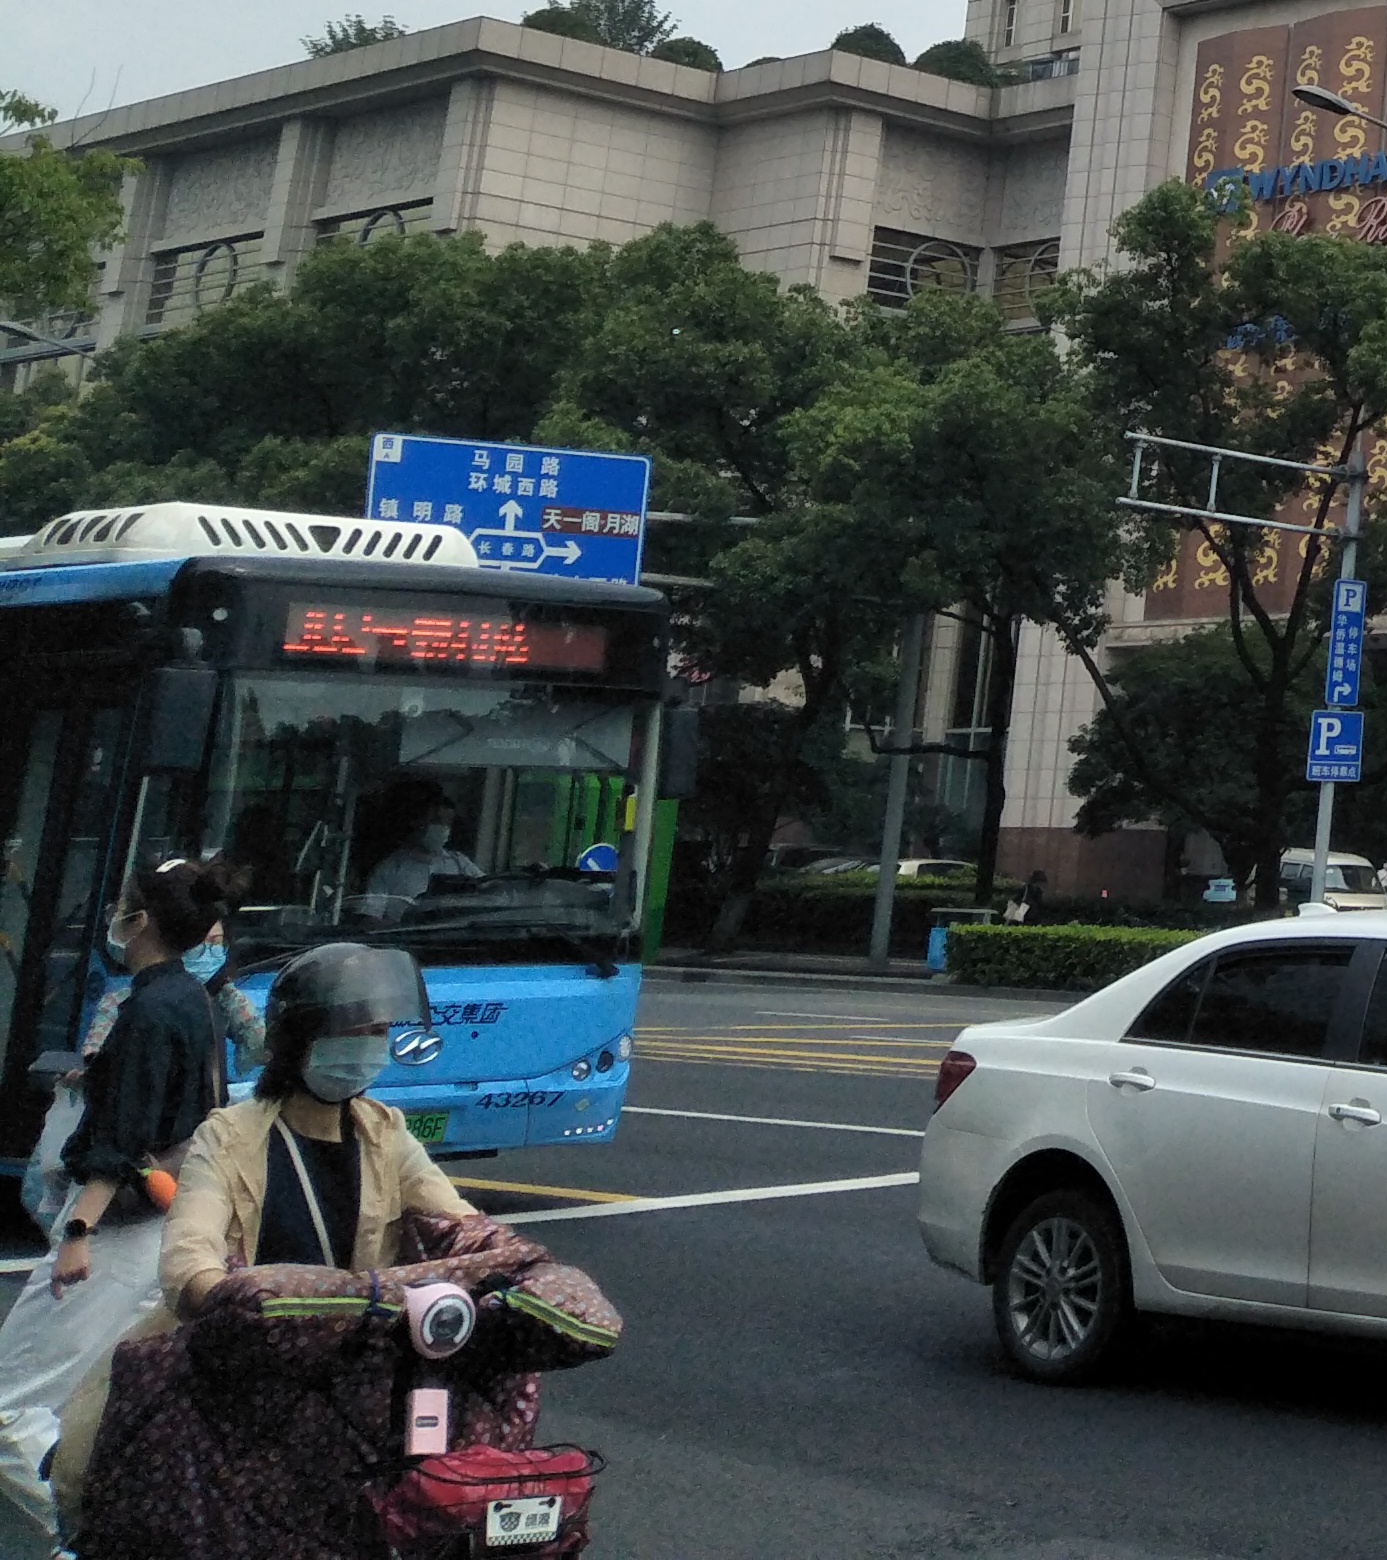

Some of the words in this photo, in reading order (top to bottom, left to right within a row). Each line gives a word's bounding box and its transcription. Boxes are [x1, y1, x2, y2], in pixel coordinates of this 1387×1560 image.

[382, 438, 394, 450] 西
[471, 449, 561, 476] 马园路
[468, 472, 559, 498] 环城西路
[378, 498, 464, 524] 镇明路
[477, 541, 536, 558] 长春路
[1344, 589, 1357, 606] P
[1346, 626, 1358, 672] 停车场
[1315, 717, 1342, 756] P
[475, 1091, 566, 1109] 43267
